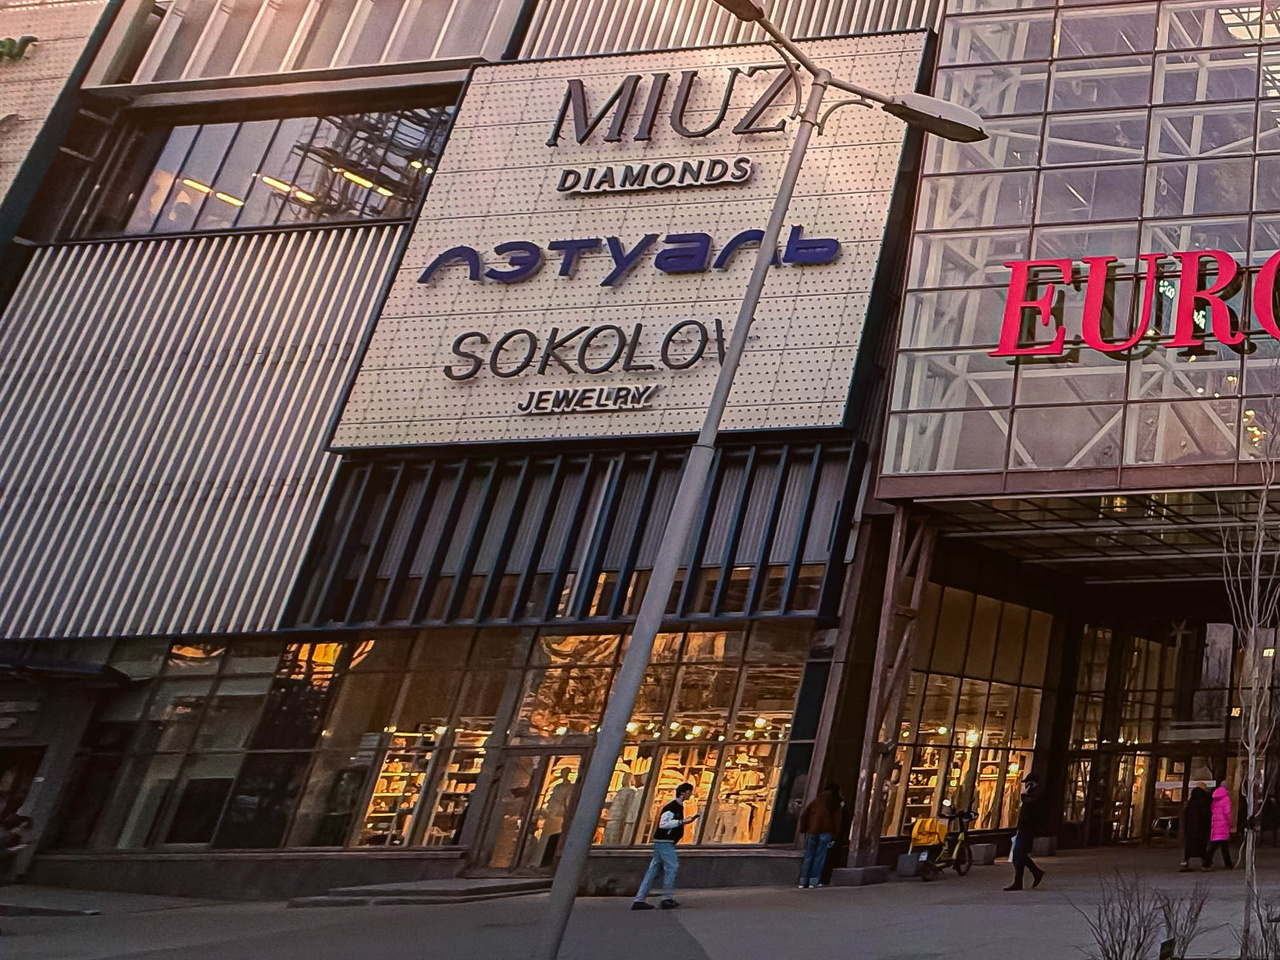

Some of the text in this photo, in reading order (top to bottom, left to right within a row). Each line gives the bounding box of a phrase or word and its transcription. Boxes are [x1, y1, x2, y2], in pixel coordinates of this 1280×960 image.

[546, 62, 800, 147] MIUZ
[556, 156, 754, 195] DIAMONDS
[517, 384, 656, 414] JEWELRY
